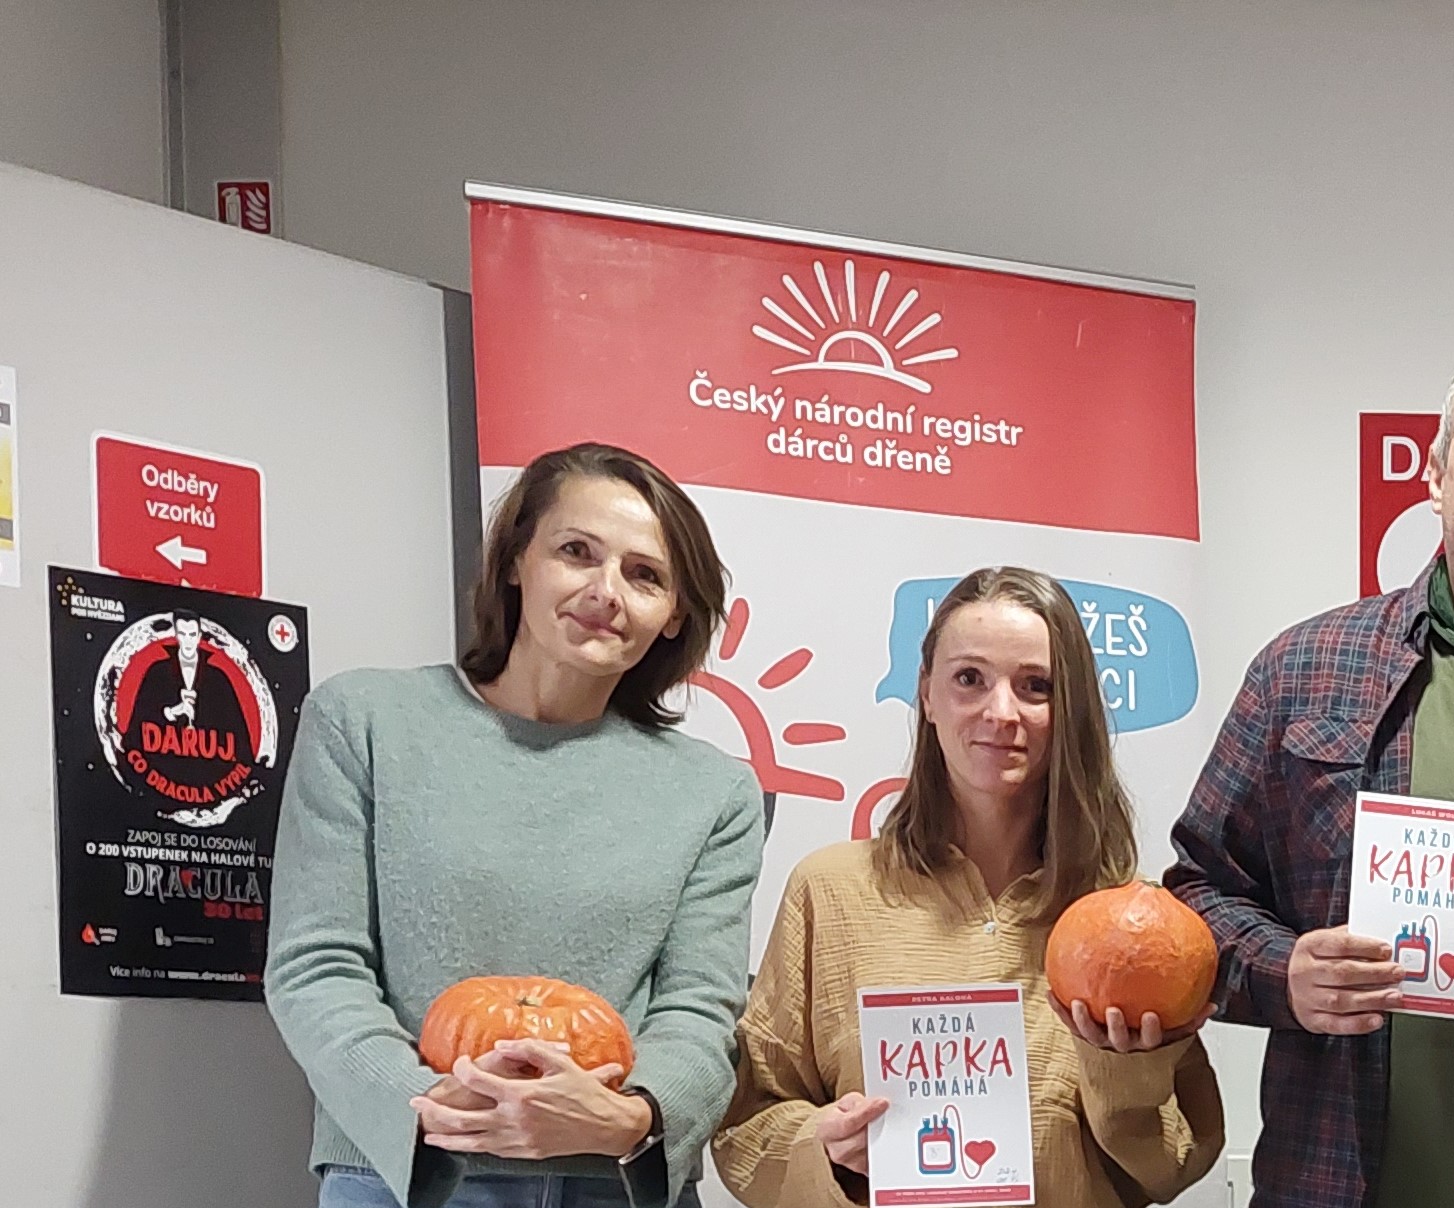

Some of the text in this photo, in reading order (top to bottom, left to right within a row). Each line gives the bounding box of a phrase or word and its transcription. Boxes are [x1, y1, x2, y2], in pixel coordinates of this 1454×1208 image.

[688, 370, 1024, 447] Český národní registr
[766, 427, 952, 475] dárců dřeně
[141, 464, 219, 503] Odběry
[145, 499, 216, 529] vzorků
[70, 593, 125, 614] KULTURA
[127, 749, 252, 804] CO DRACULA VYPIL
[85, 842, 97, 855] O
[98, 843, 120, 857] 200
[121, 845, 189, 863] VSTUPENEK
[191, 850, 209, 864] NA
[210, 851, 256, 868] HALOVÉ
[126, 829, 257, 852] ZAPOJ SE DO LOSOVÁNÍ
[124, 861, 265, 904] DRACULA
[911, 1012, 976, 1035] KAŽDÁ
[880, 1036, 1013, 1082] KAPKA
[909, 1075, 988, 1098] POMÁHÁ
